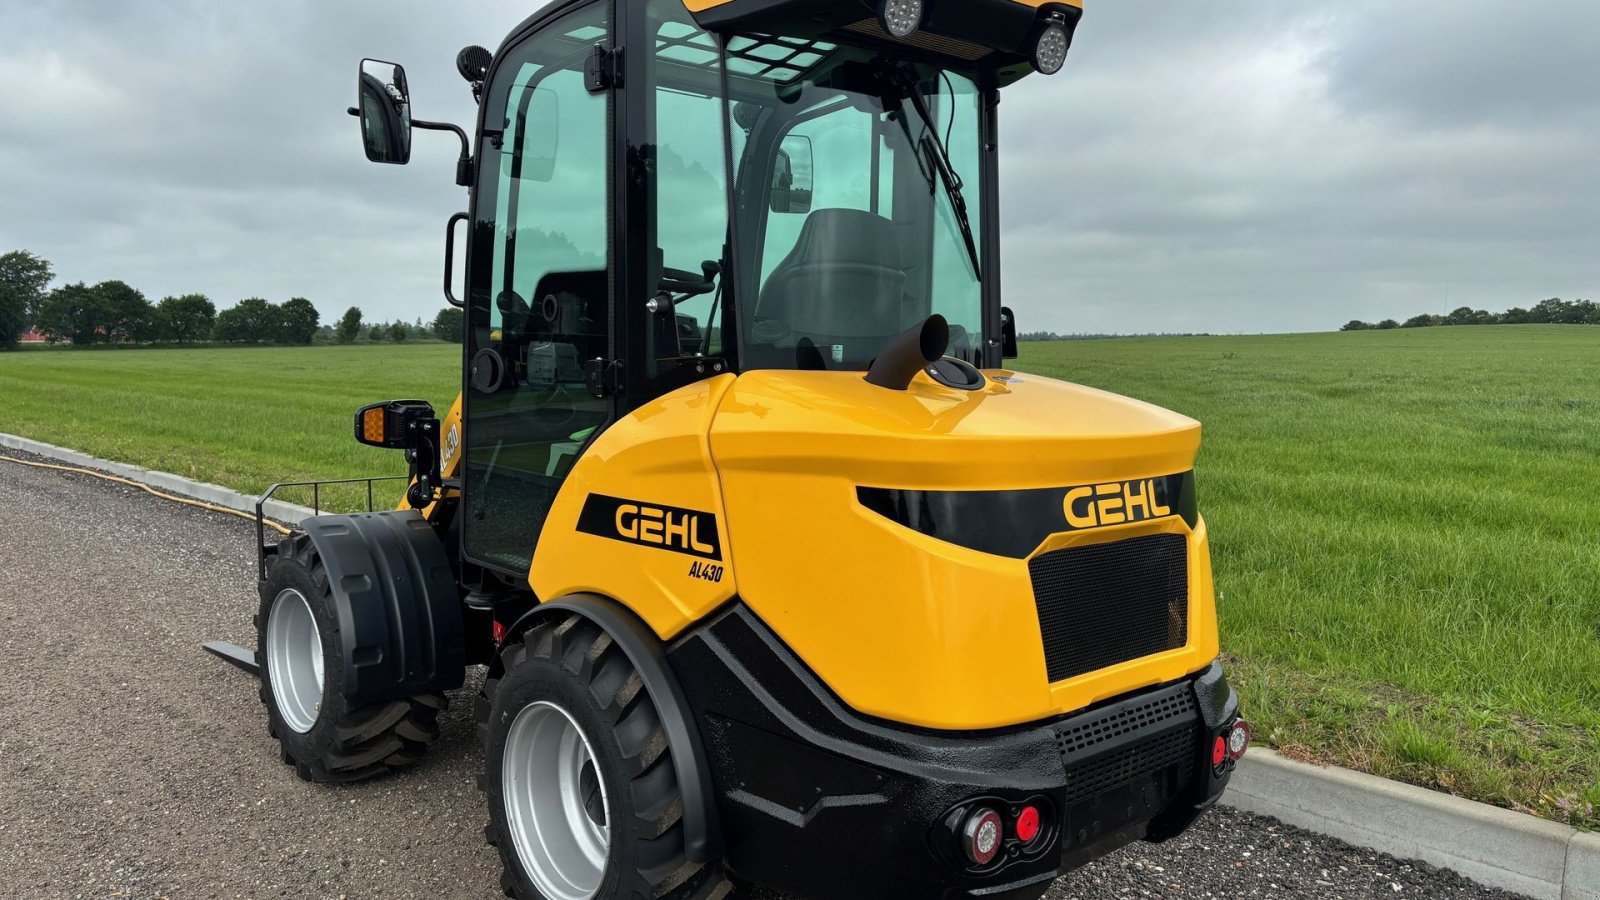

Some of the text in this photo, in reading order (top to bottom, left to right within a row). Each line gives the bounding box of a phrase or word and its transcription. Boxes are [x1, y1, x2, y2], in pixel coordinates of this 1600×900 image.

[440, 423, 459, 472] L430
[1063, 479, 1171, 528] GEHL
[615, 504, 714, 554] GEHL
[688, 561, 724, 583] AL430
